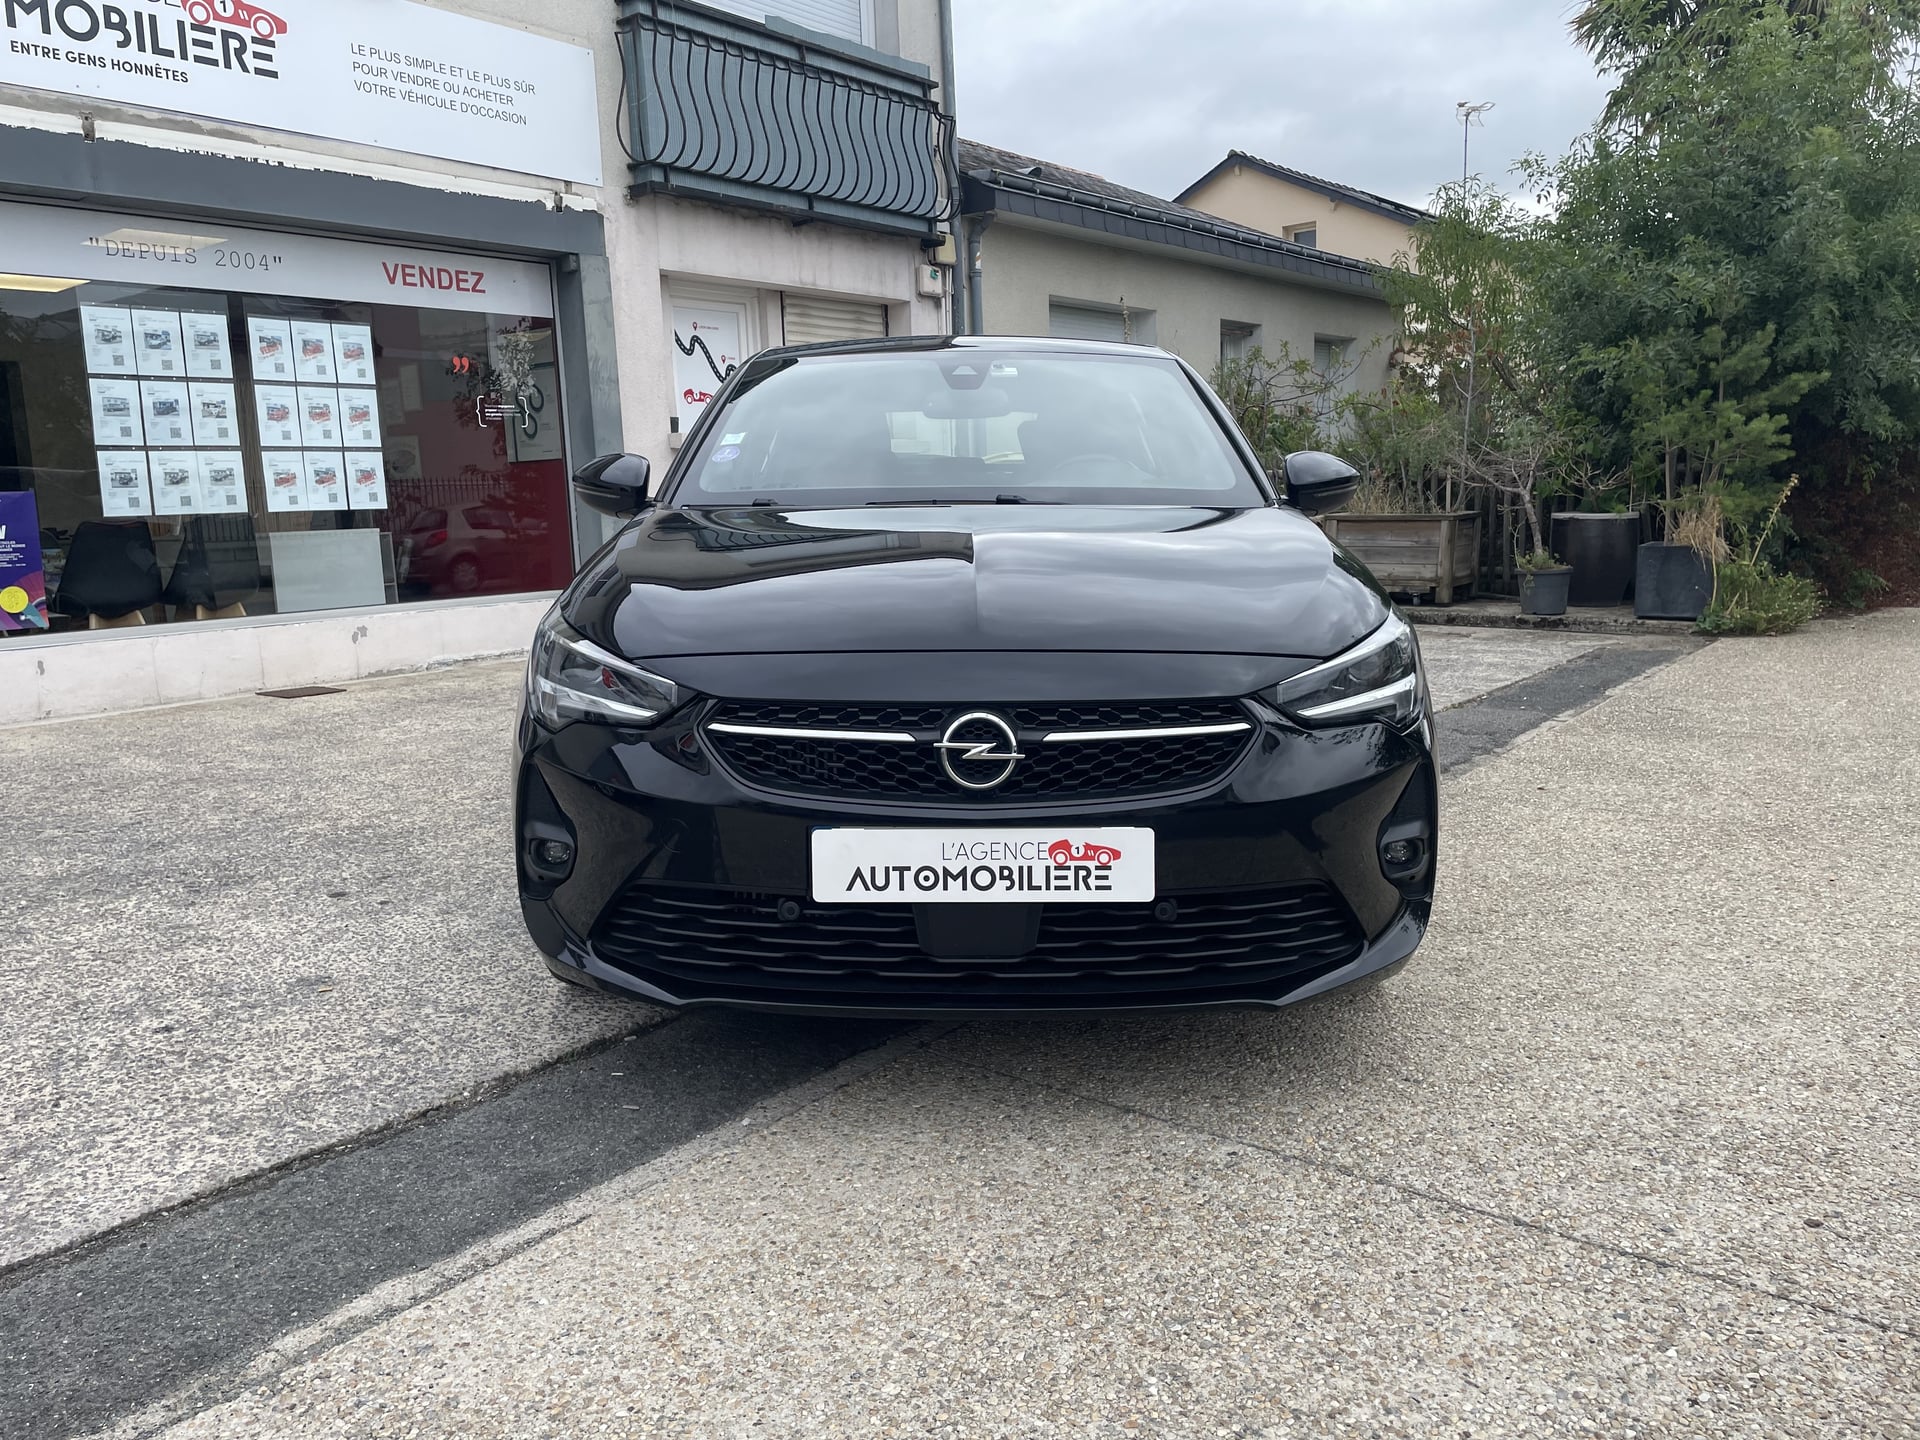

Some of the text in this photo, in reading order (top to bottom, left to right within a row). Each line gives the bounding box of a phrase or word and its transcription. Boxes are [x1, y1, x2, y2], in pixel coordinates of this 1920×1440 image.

[10, 39, 189, 83] ENTRE GENS HONNÊTES
[350, 42, 536, 95] LE PLUS SIMPLE ET LE PLUS SÛR
[352, 61, 514, 107] POUR VENDRE OU ACHETER
[354, 79, 527, 126] VOTRE VÉHICULE D'OCCASION
[381, 261, 486, 294] VENDEZ
[942, 842, 1049, 861] L'AGENCE
